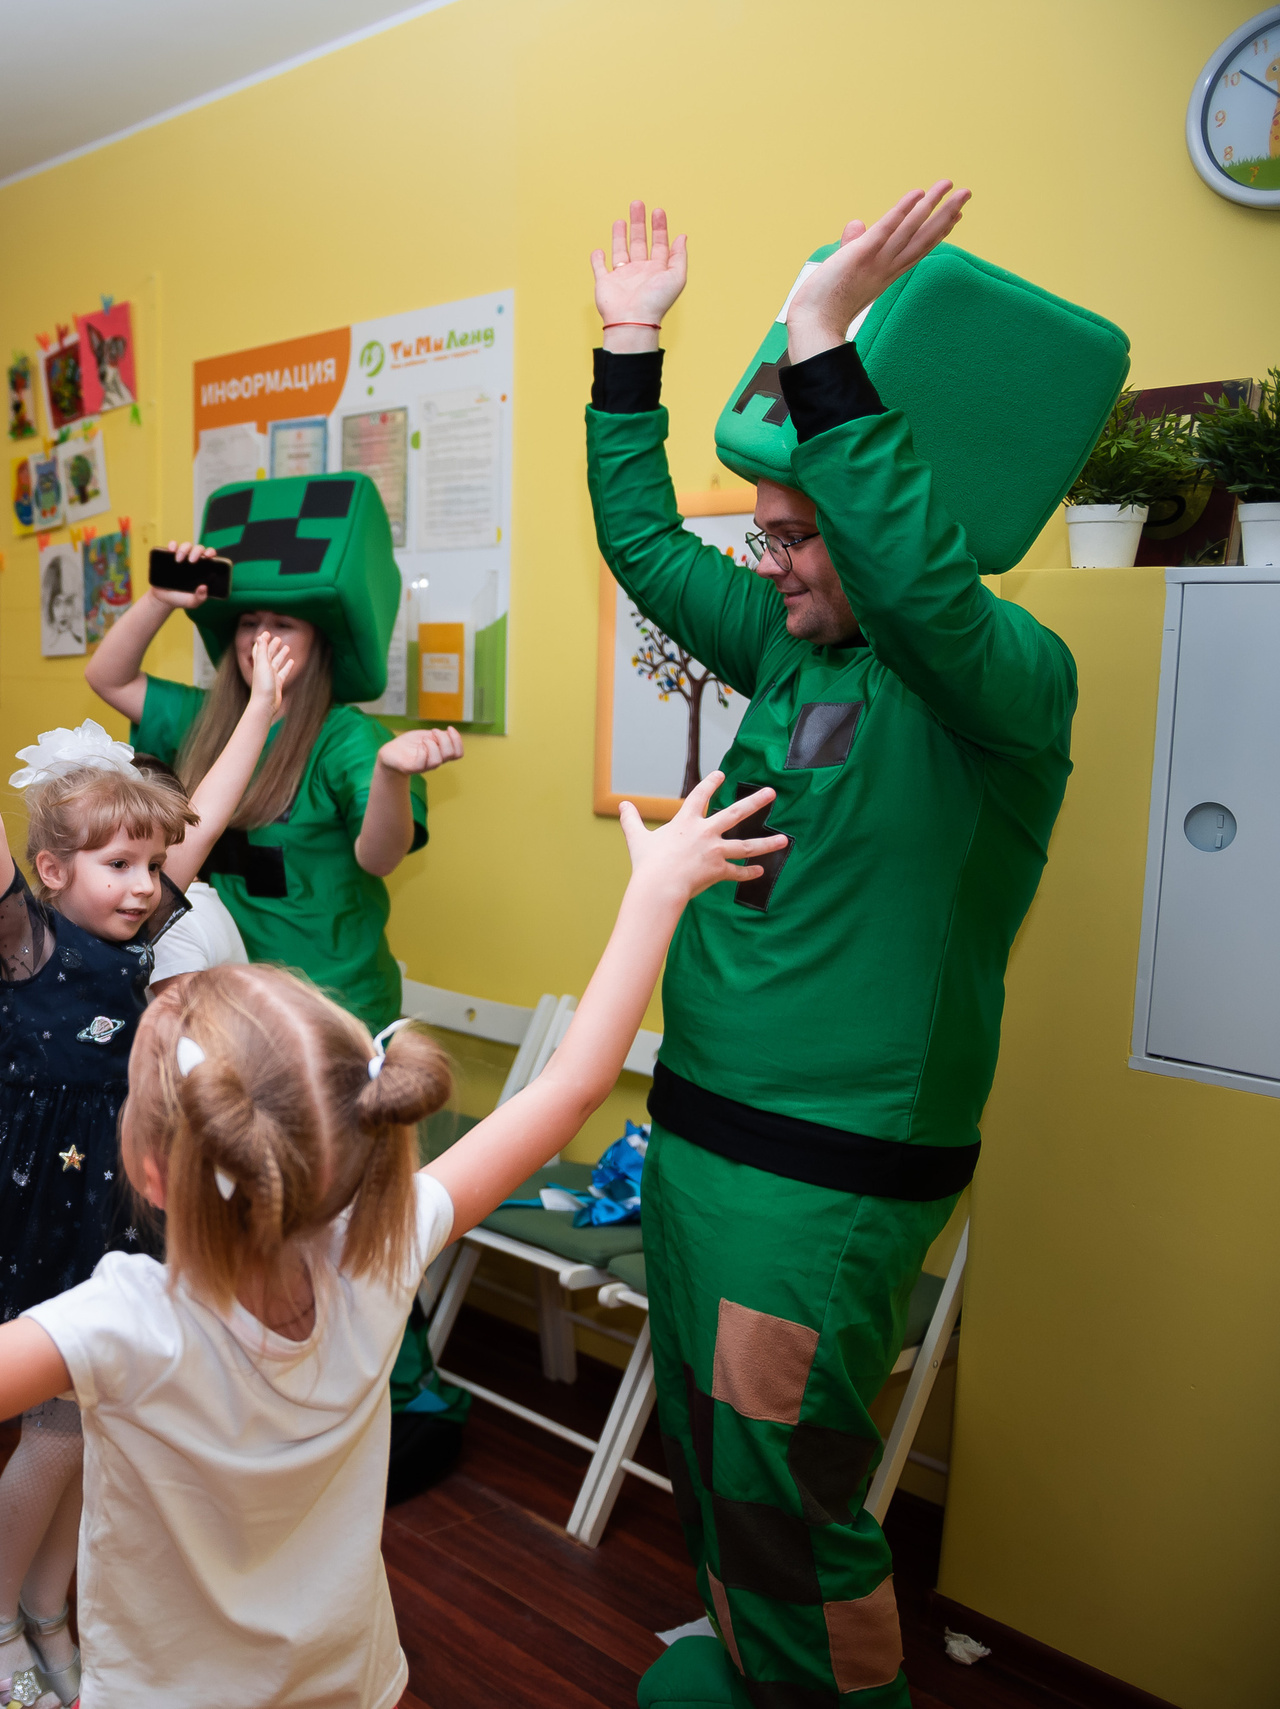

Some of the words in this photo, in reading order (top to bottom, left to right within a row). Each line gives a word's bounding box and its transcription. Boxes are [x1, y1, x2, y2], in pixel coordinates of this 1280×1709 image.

[1224, 72, 1241, 88] 10
[1215, 110, 1227, 128] 9
[1223, 146, 1234, 161] 8
[1250, 166, 1260, 182] 7
[201, 358, 337, 407] ИНФОРМАЦИЯ
